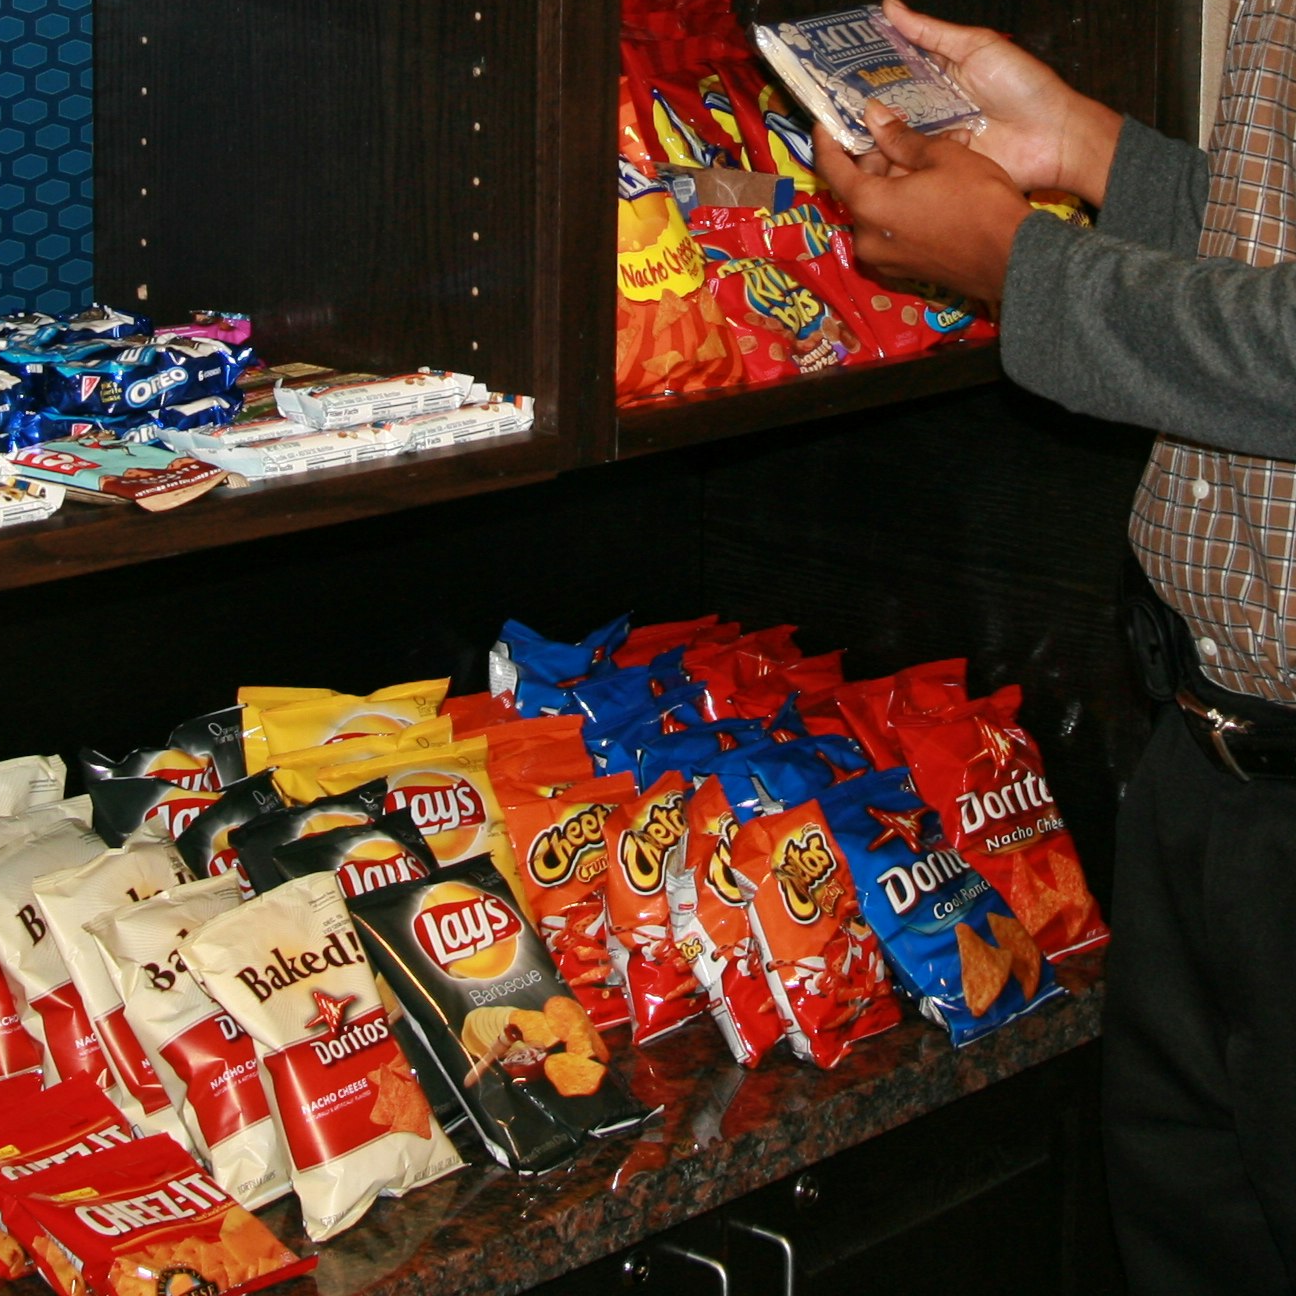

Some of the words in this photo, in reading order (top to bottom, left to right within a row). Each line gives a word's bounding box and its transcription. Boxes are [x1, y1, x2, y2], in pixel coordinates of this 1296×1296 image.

[816, 23, 858, 53] ACT
[858, 64, 913, 87] Butter
[619, 258, 669, 289] Nacho
[770, 288, 821, 336] bits
[130, 368, 188, 405] OREO
[985, 825, 1035, 853] Nacho
[932, 891, 962, 921] Cool
[421, 894, 510, 966] Lay's
[235, 930, 367, 1003] Baked!
[468, 968, 543, 1007] Barbecue
[310, 1017, 389, 1066] Doritos
[209, 1065, 245, 1091] NACHO
[301, 1092, 337, 1116] NACHO
[337, 1077, 369, 1099] CHEESE
[74, 1172, 227, 1238] CHEEZ-IT
